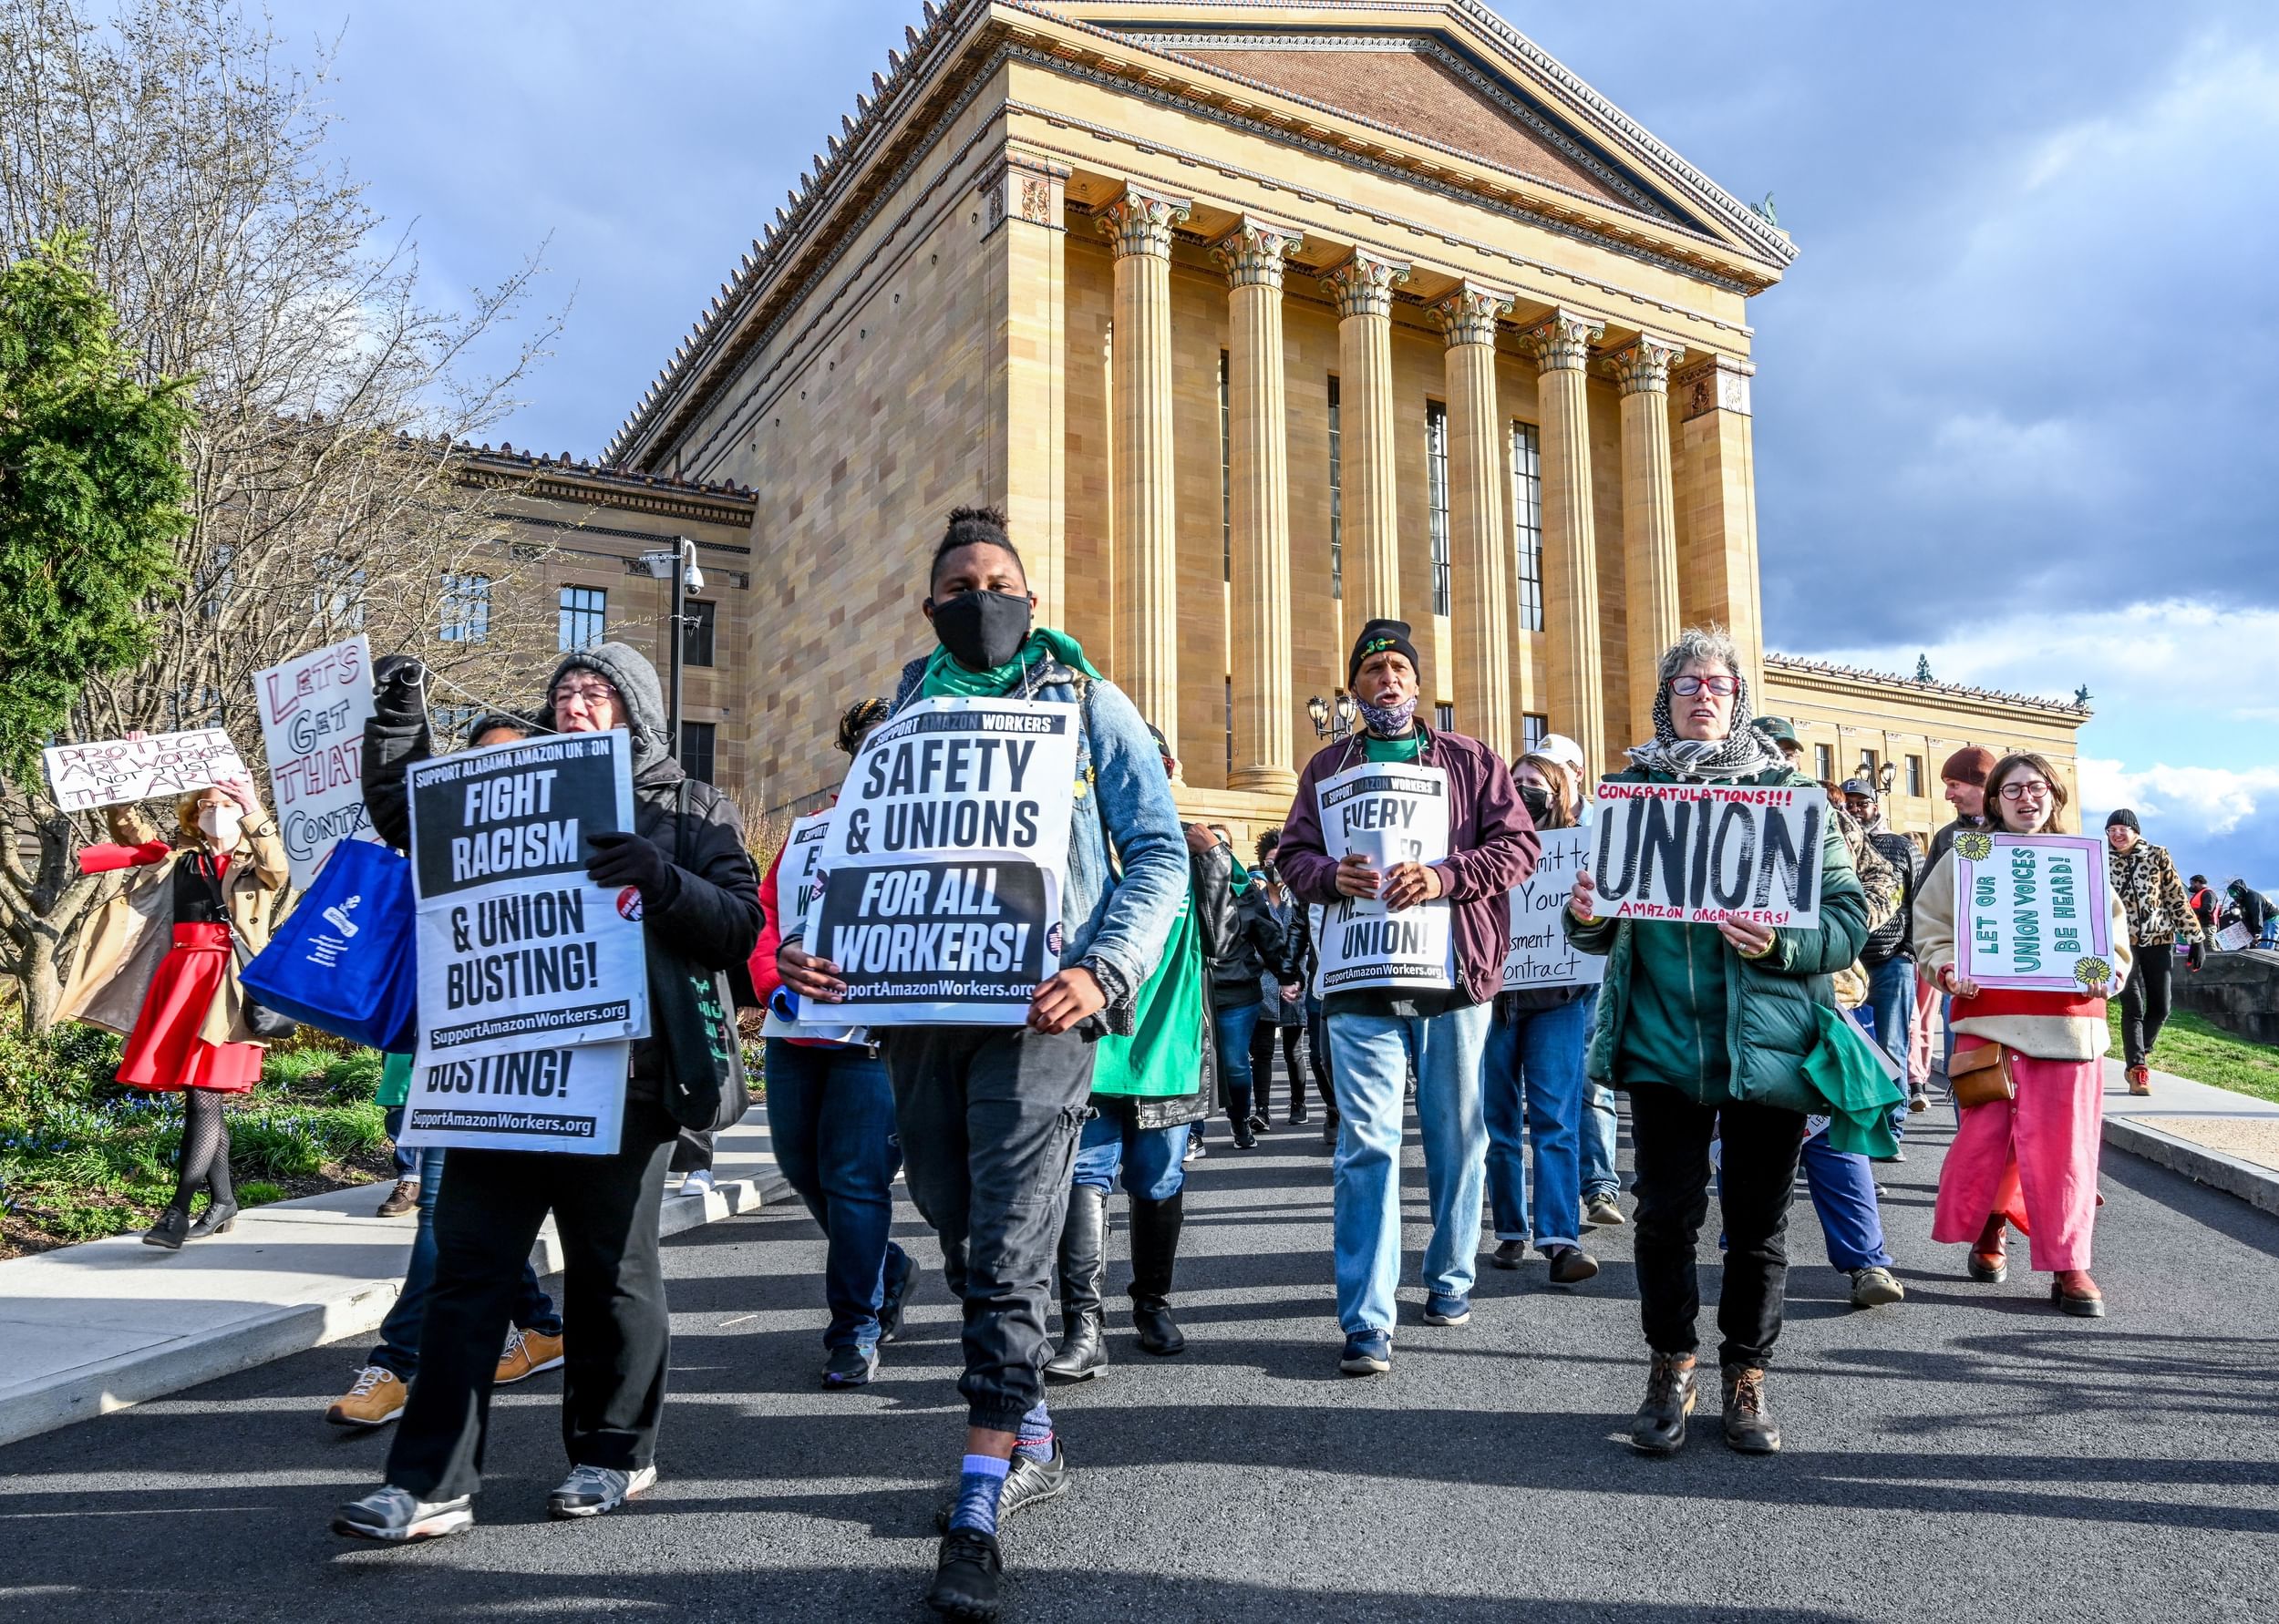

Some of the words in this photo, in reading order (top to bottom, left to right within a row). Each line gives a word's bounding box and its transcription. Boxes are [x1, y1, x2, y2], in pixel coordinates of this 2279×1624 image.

[266, 644, 359, 725] LET'S
[288, 698, 350, 755] GET
[874, 717, 920, 746] SUPPORT
[922, 714, 979, 731] AMAZON
[982, 714, 1052, 733] WORKERS
[58, 732, 219, 766] PROTECT
[60, 757, 121, 781] ART
[130, 744, 236, 769] WORKERS
[416, 764, 461, 788] SUPPORT
[462, 754, 513, 777] ALABAMA
[514, 745, 563, 766] AMAZON
[564, 739, 610, 758] UNON
[66, 784, 129, 805] THE
[145, 766, 219, 796] ART
[97, 770, 141, 786] NOT
[151, 759, 213, 776] JUST
[275, 734, 365, 805] THAT
[861, 739, 1036, 800] SAFETY
[1847, 780, 1856, 790] P
[463, 769, 557, 827] FIGHT
[1329, 784, 1353, 804] SUPPORT
[1354, 777, 1388, 791] AMAZON
[1391, 777, 1433, 794] WORKERS
[1597, 784, 1792, 807] CONGRATULATIONS!!!
[846, 808, 871, 855] &
[883, 799, 1039, 851] UNIONS
[1343, 798, 1418, 838] EVERY
[451, 818, 579, 882] RACISM
[1595, 794, 1820, 912] UNION
[858, 869, 931, 918] FOR
[932, 868, 1001, 915] ALL
[1520, 880, 1572, 913] Your
[1975, 877, 1996, 907] OUR
[2012, 848, 2037, 907] VOICES
[2048, 857, 2077, 919] HEARD!
[451, 906, 473, 953] &
[478, 888, 584, 948] UNION
[1616, 901, 1684, 919] AMAZON
[832, 922, 1031, 973] WORKERS!
[1342, 920, 1428, 960] UNION!
[1976, 916, 1998, 953] LET
[2013, 910, 2041, 972] UNION
[2054, 928, 2081, 952] BE
[448, 941, 598, 1011] BUSTING!
[820, 980, 1036, 1001] portAmazonWorkers.org
[1325, 964, 1441, 984] SupportAmazonWorkers.org
[432, 1004, 626, 1045] SupportAmazonWorkers.org
[412, 1111, 592, 1136] SupportAmazonWorkers.org
